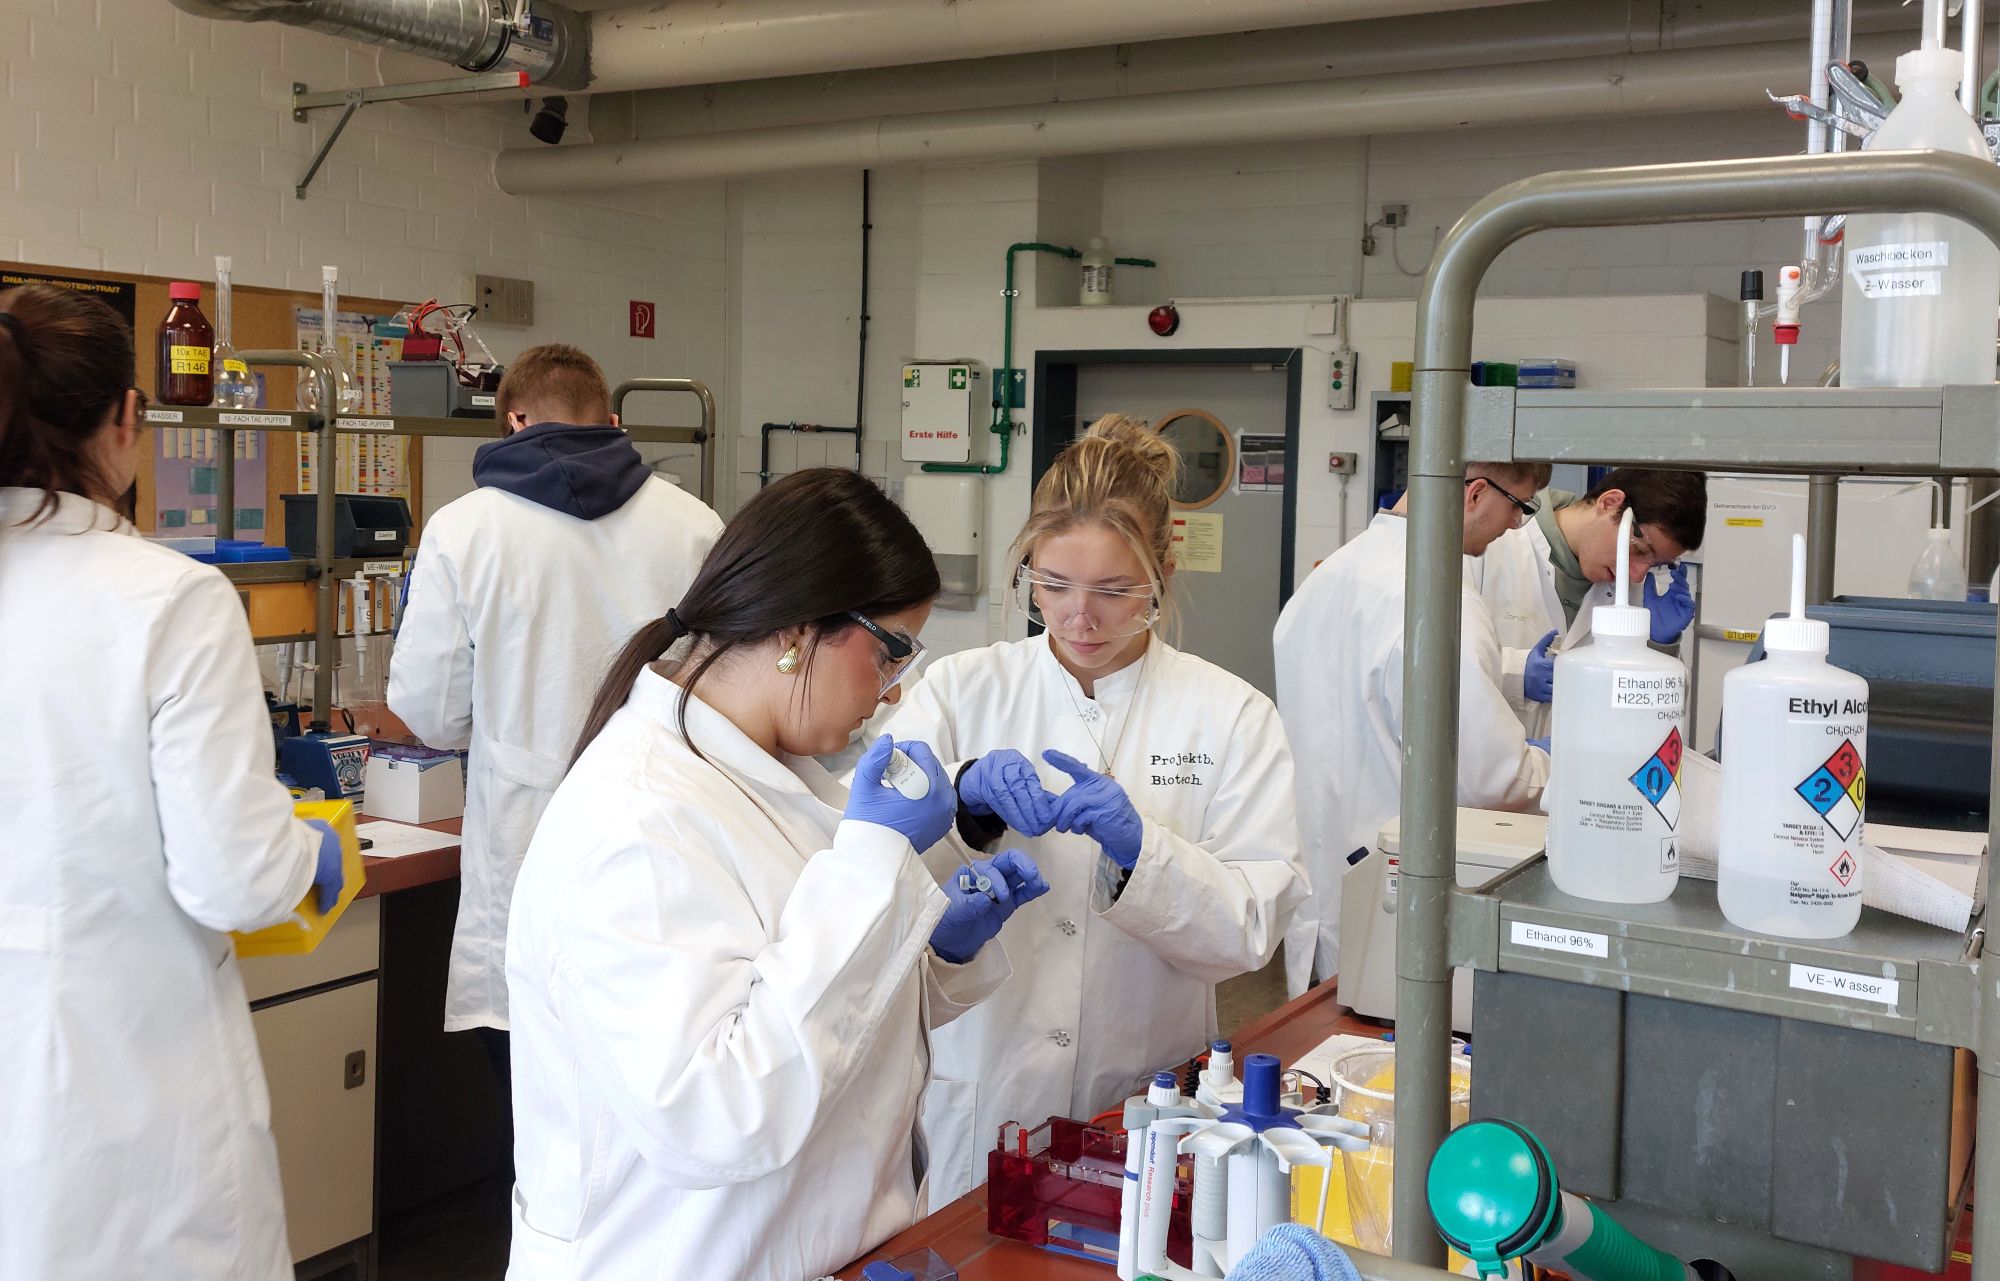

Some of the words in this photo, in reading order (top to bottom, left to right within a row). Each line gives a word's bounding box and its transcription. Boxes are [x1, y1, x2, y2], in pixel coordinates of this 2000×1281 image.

[95, 285, 121, 293] TRAIT
[193, 349, 208, 357] TAE
[176, 364, 206, 373] R146
[909, 430, 934, 439] Erste
[936, 431, 959, 440] Hilfe
[1727, 630, 1758, 641] STOPP
[1618, 676, 1663, 689] Ethanol
[1665, 676, 1677, 689] 96
[1617, 692, 1656, 706] H225,
[1657, 691, 1680, 705] P210
[1789, 697, 1838, 718] Ethyl
[1842, 698, 1869, 715] Alco
[1150, 752, 1214, 767] Projektb.
[1667, 739, 1680, 767] 3
[1839, 751, 1853, 778] 3
[1646, 765, 1664, 797] 0
[1813, 777, 1832, 803] 2
[1856, 776, 1864, 802] 0
[1526, 928, 1567, 945] Ethanol
[1569, 935, 1594, 949] 96%
[1145, 1165, 1155, 1201] Research
[1143, 1202, 1151, 1218] plus
